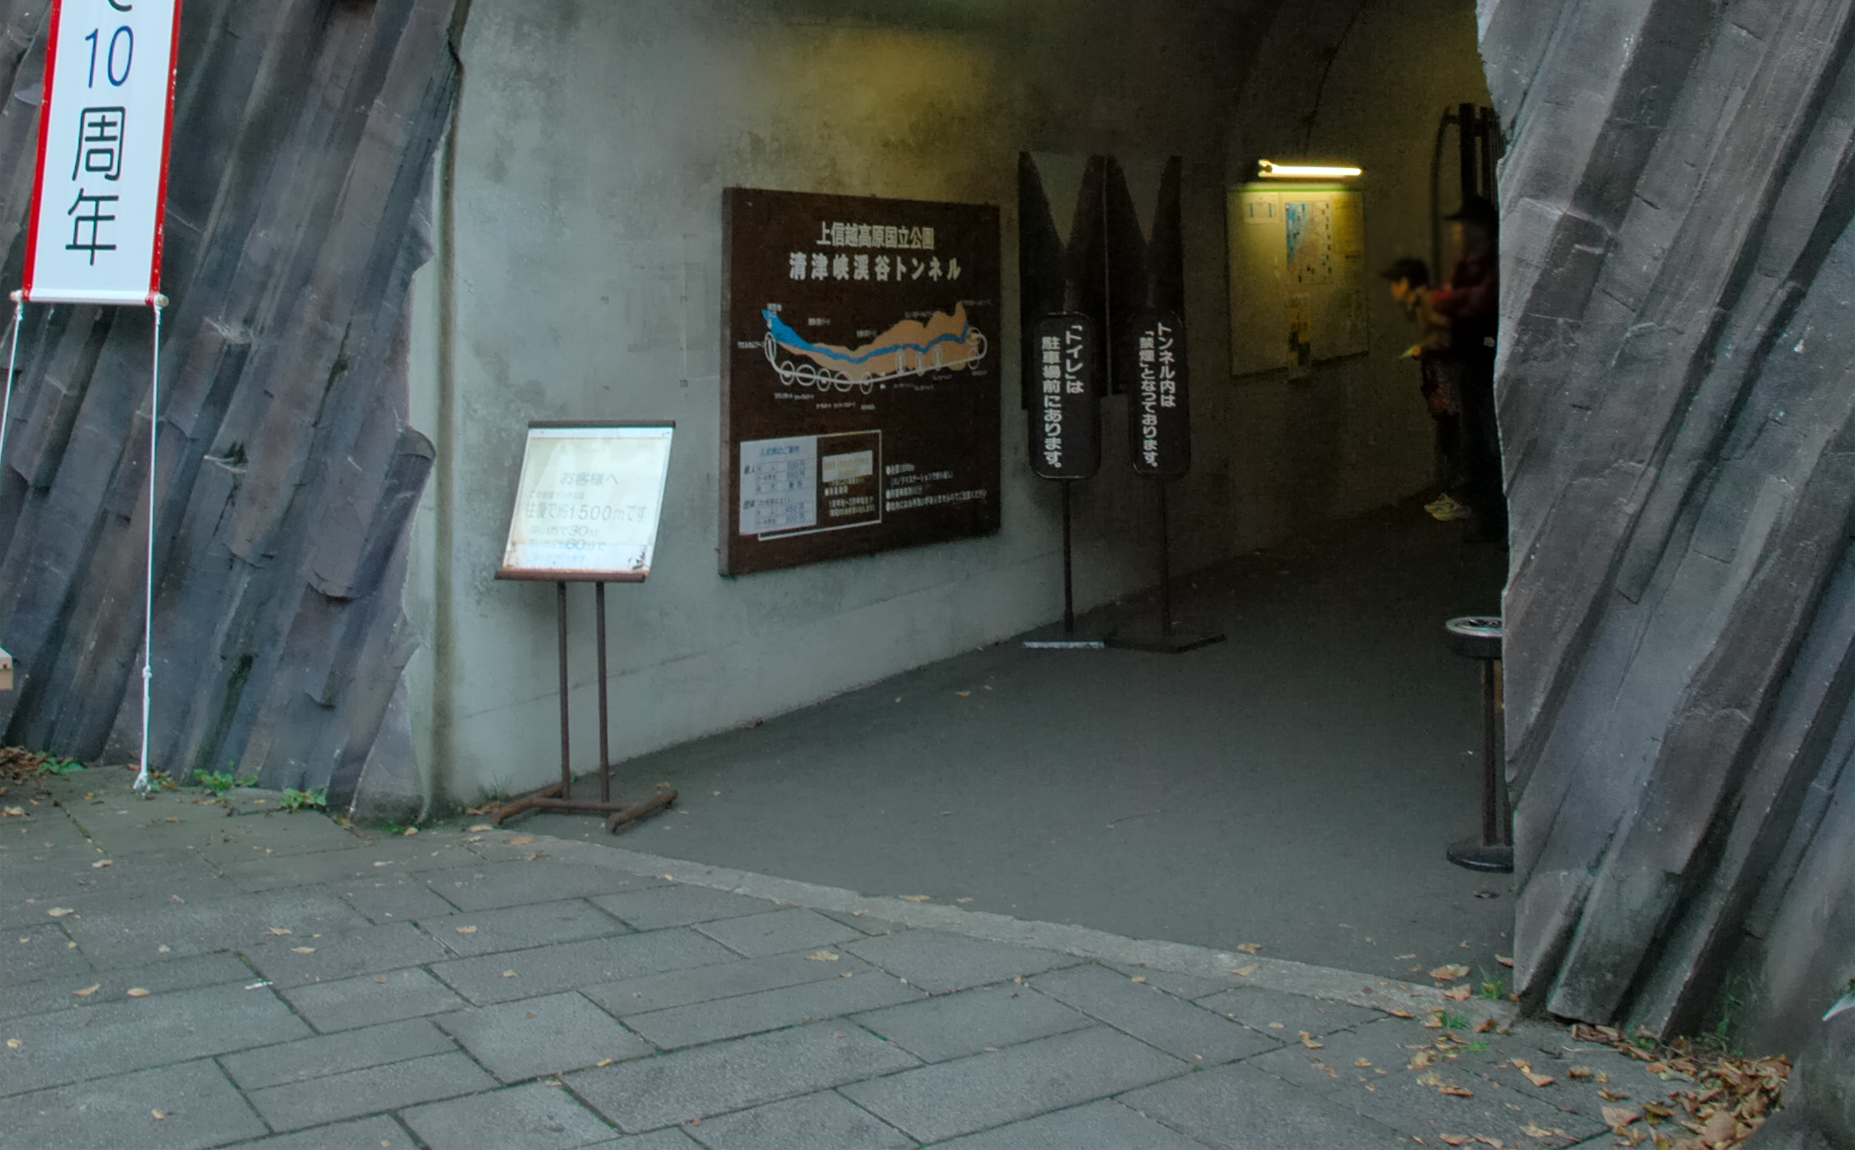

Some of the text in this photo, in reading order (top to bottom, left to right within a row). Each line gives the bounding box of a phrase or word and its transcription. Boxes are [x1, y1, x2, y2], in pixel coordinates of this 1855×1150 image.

[817, 221, 935, 250] 上信越高原国立公園
[789, 252, 961, 281] 清津峡渓谷トンネル
[1065, 325, 1084, 394] 「トイレ」は
[1157, 322, 1176, 407] トンネル内は
[1042, 336, 1062, 468] 駐車場前にあります。
[560, 472, 618, 486] お客様へ
